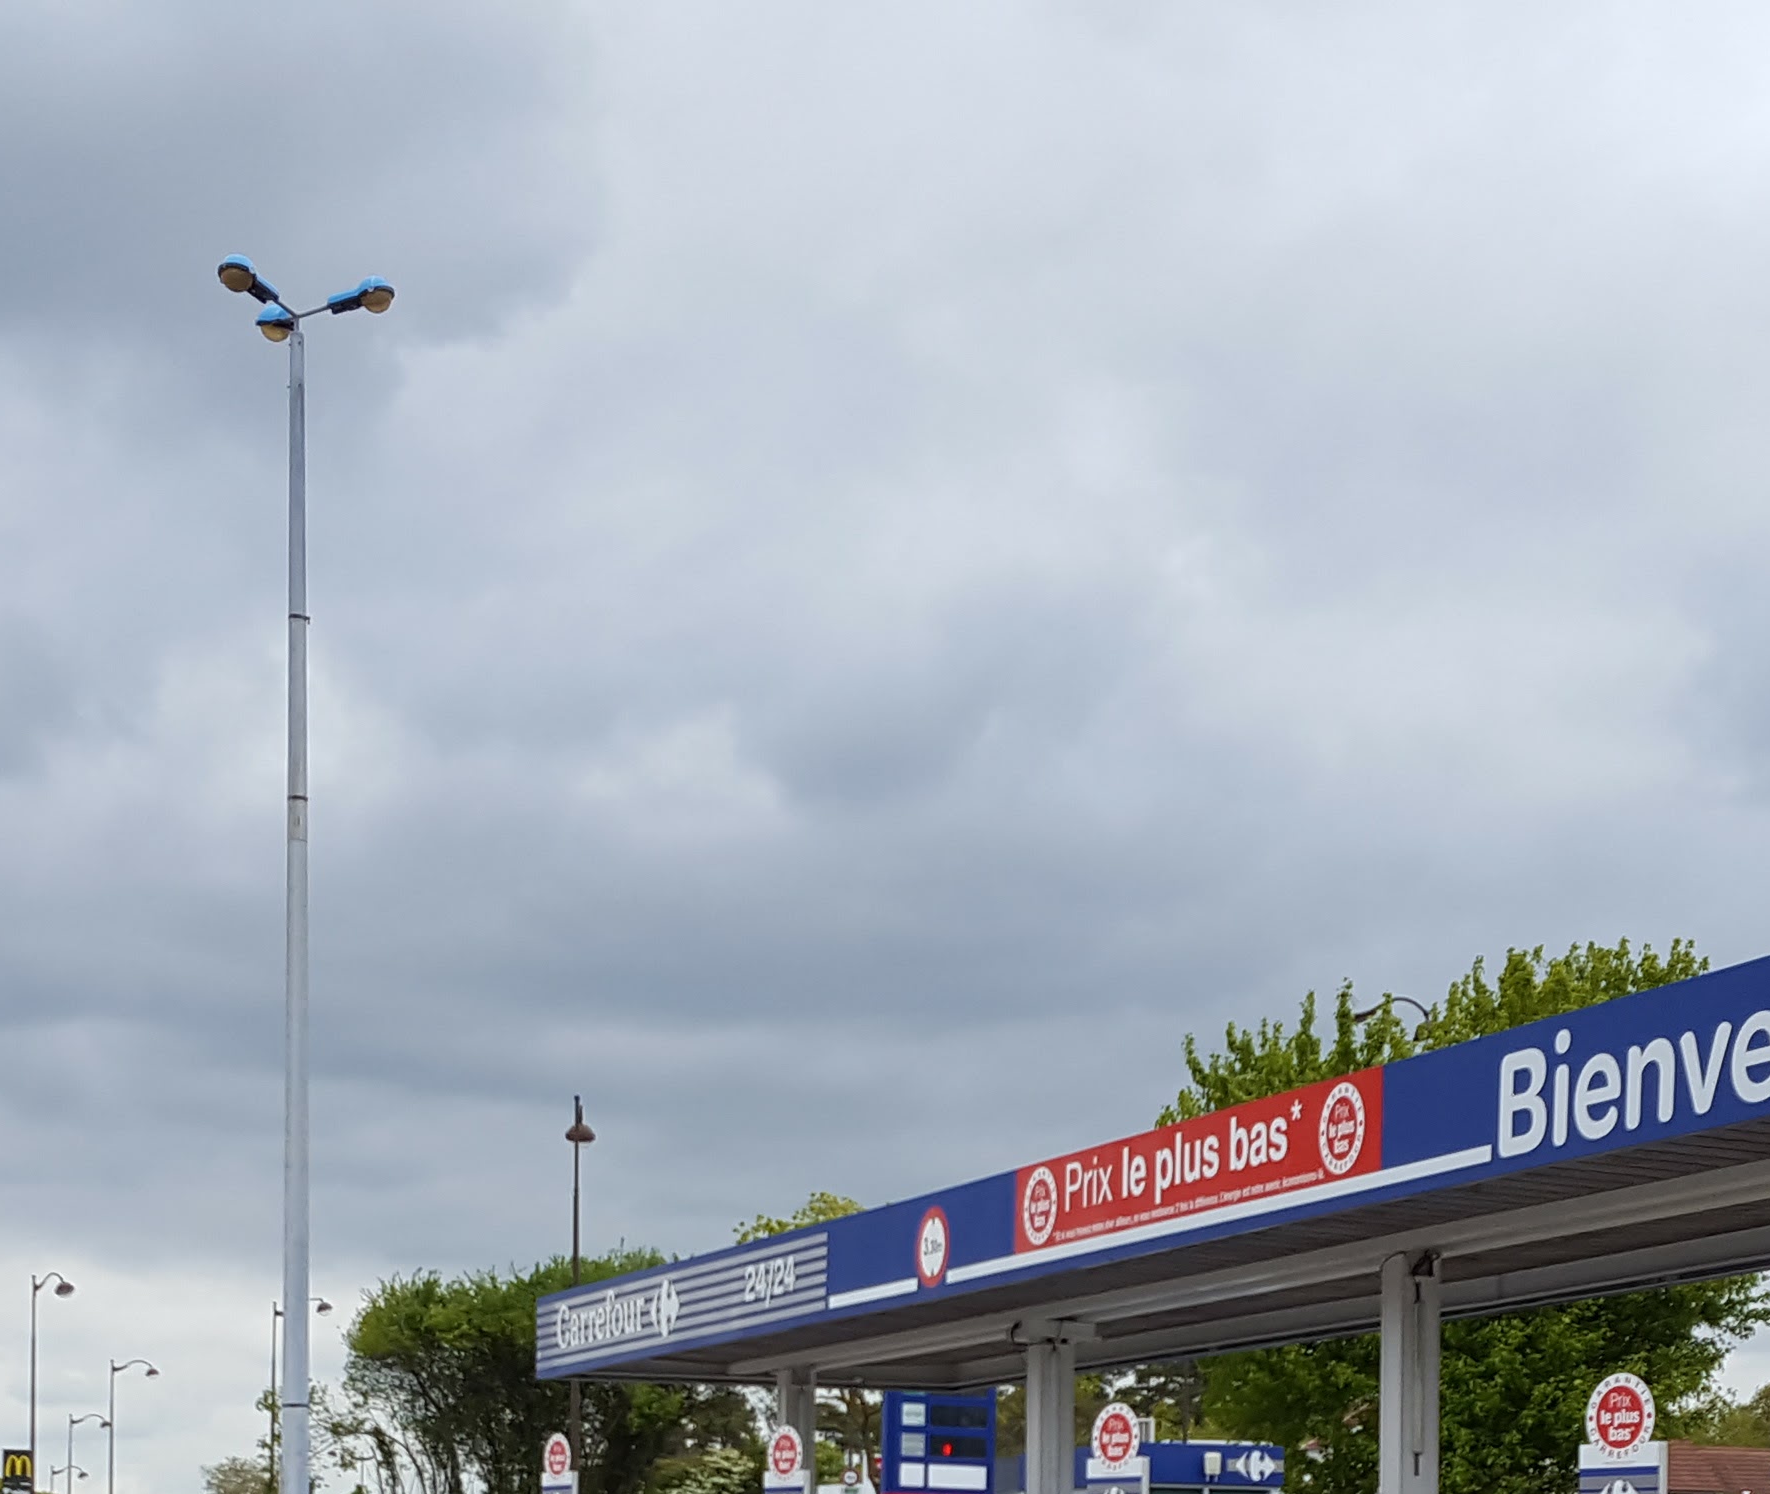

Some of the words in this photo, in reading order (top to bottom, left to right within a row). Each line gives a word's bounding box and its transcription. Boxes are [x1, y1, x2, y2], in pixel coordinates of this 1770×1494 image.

[1065, 1156, 1113, 1213] Prix
[1122, 1143, 1147, 1198] le
[1155, 1132, 1220, 1205] plus
[557, 1288, 645, 1349] Carrefour
[744, 1255, 796, 1308] 24/24
[1600, 1410, 1612, 1425] le
[1614, 1409, 1640, 1427] plus
[1610, 1392, 1631, 1407] Prix
